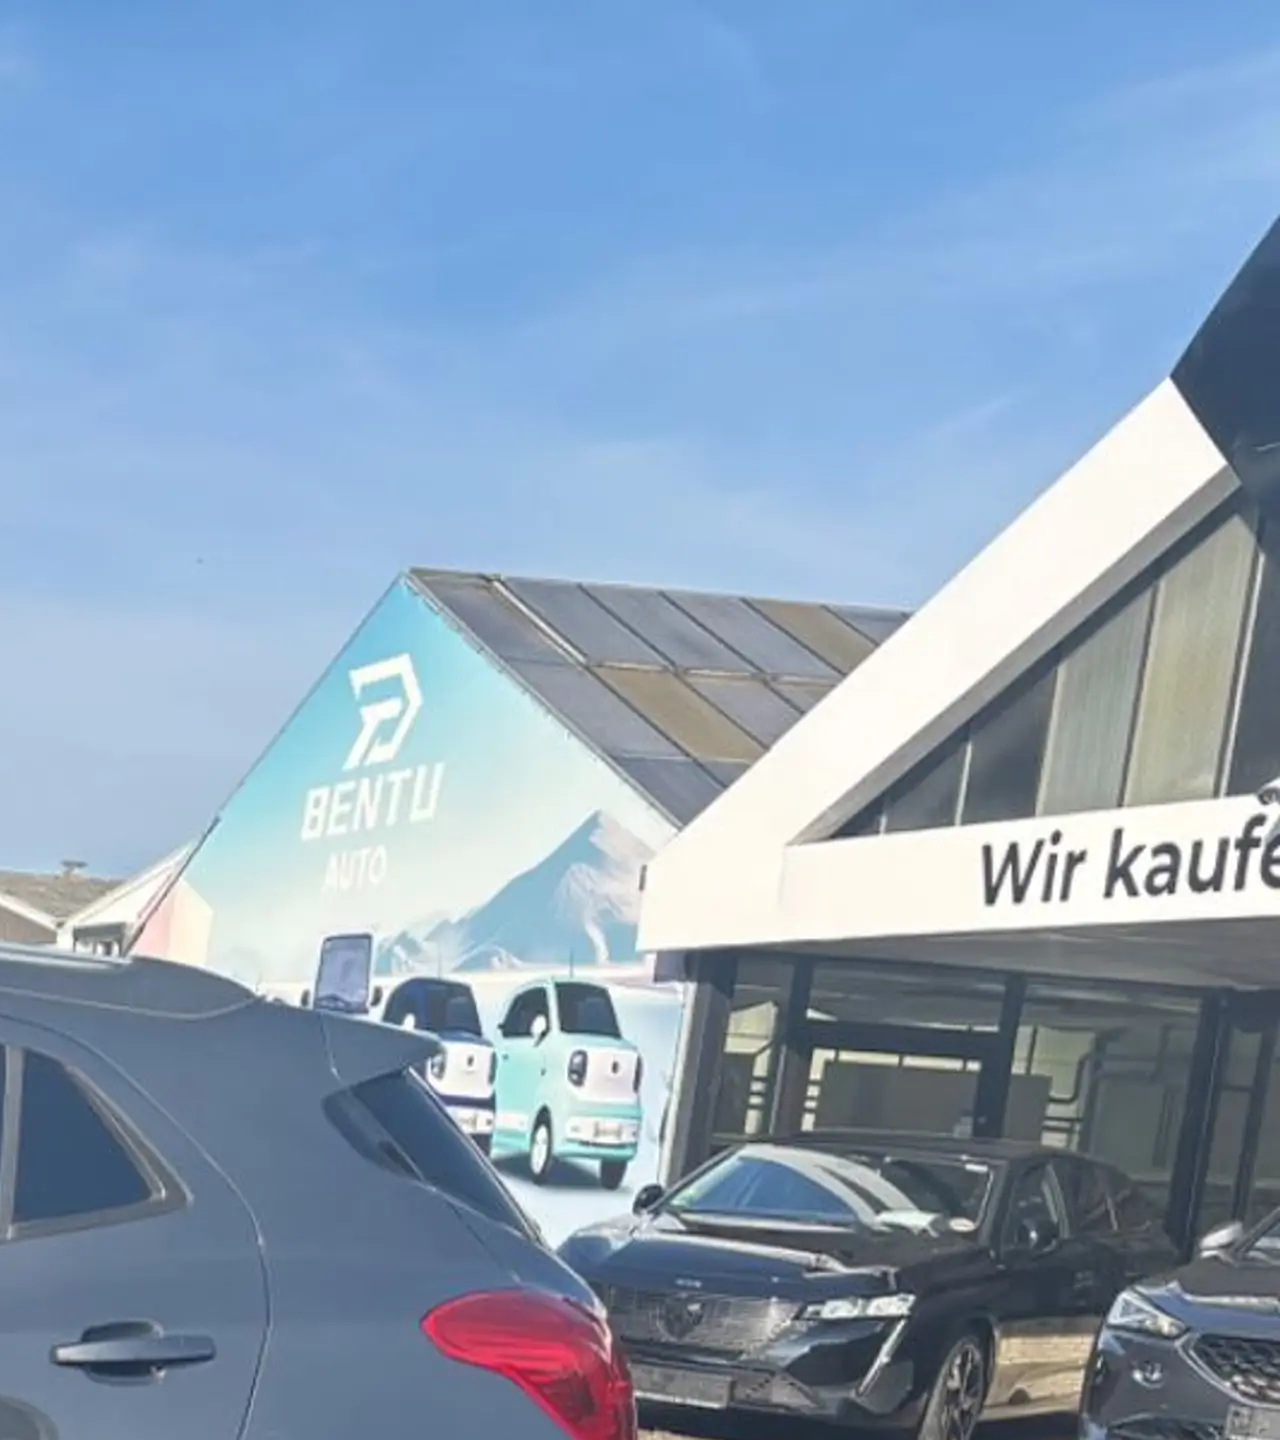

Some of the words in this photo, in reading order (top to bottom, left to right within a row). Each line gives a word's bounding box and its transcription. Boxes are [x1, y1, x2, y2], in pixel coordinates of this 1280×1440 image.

[301, 762, 446, 841] BENTU
[321, 845, 389, 894] AUTO
[982, 828, 1088, 906] Wir
